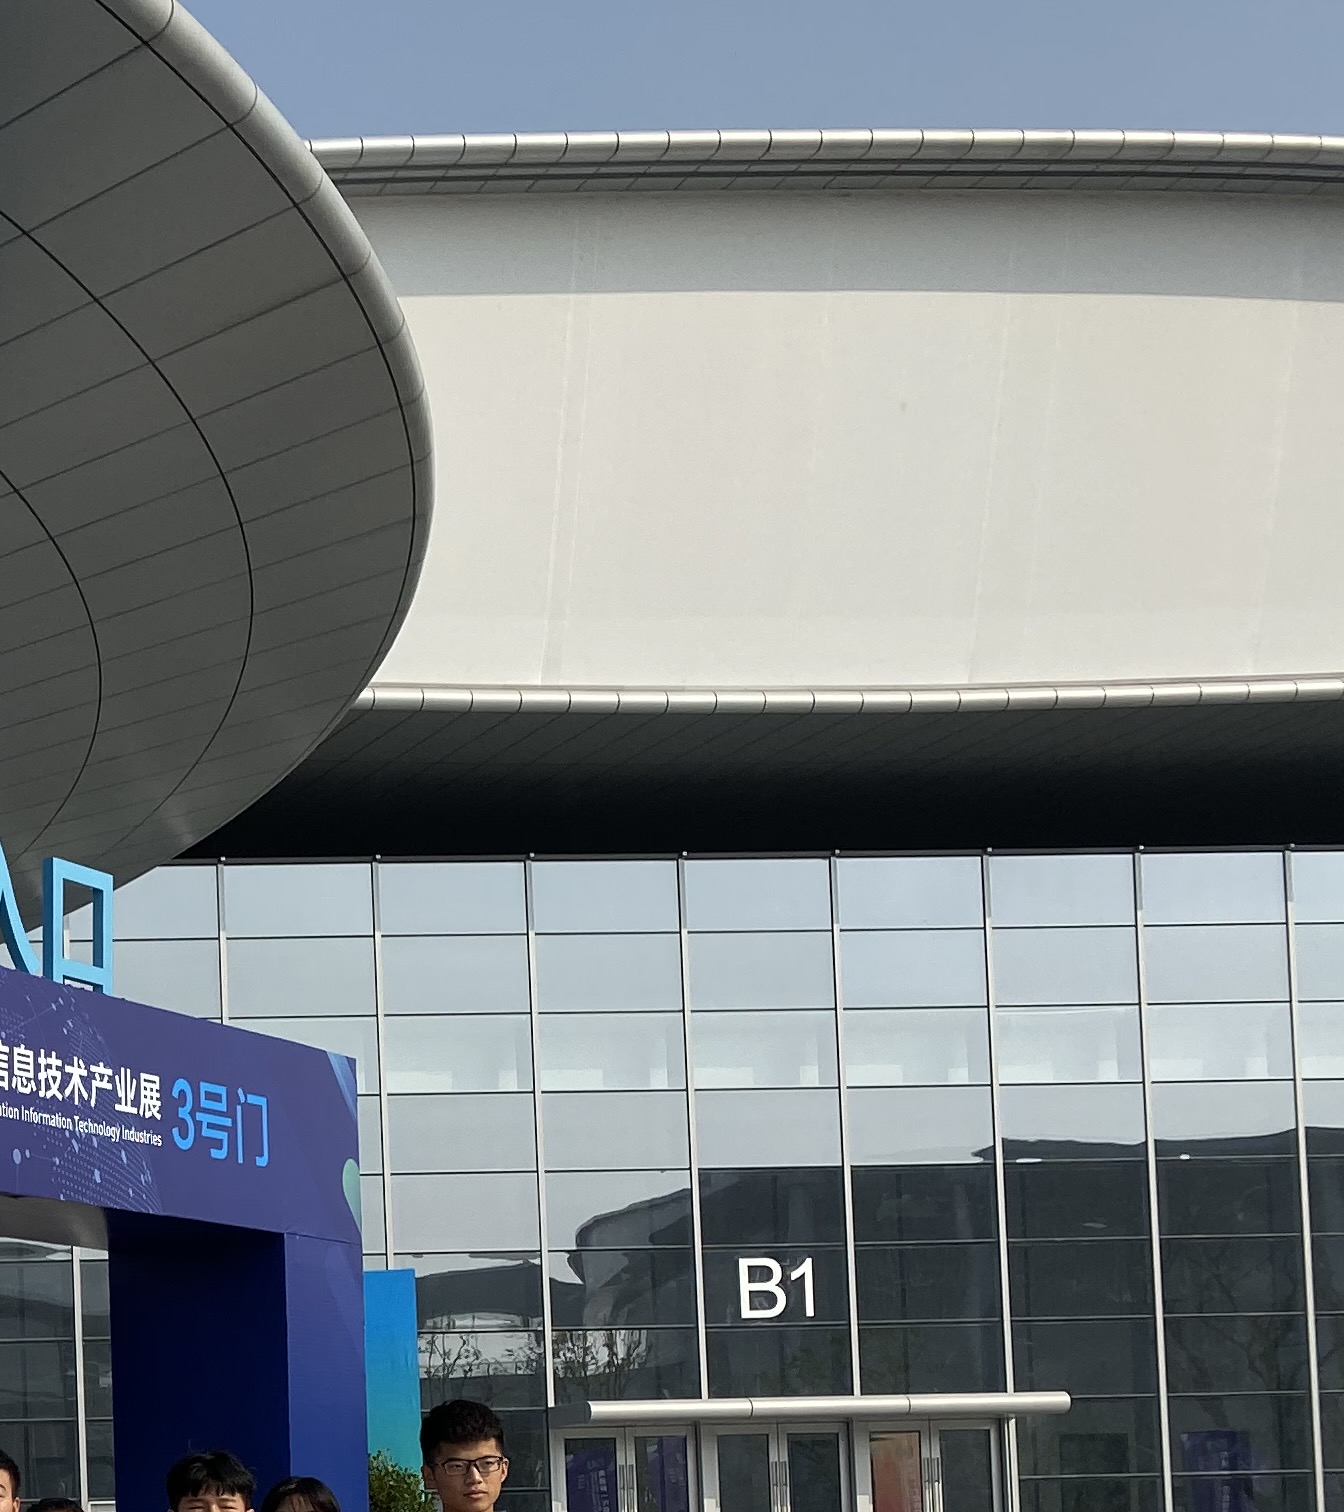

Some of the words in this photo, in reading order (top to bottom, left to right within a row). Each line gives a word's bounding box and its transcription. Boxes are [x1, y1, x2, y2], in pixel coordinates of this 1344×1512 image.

[21, 1105, 73, 1131] Information
[74, 1115, 120, 1142] Technology
[122, 1124, 162, 1147] Industries
[171, 1077, 270, 1167] 3号门
[738, 1257, 815, 1320] B1
